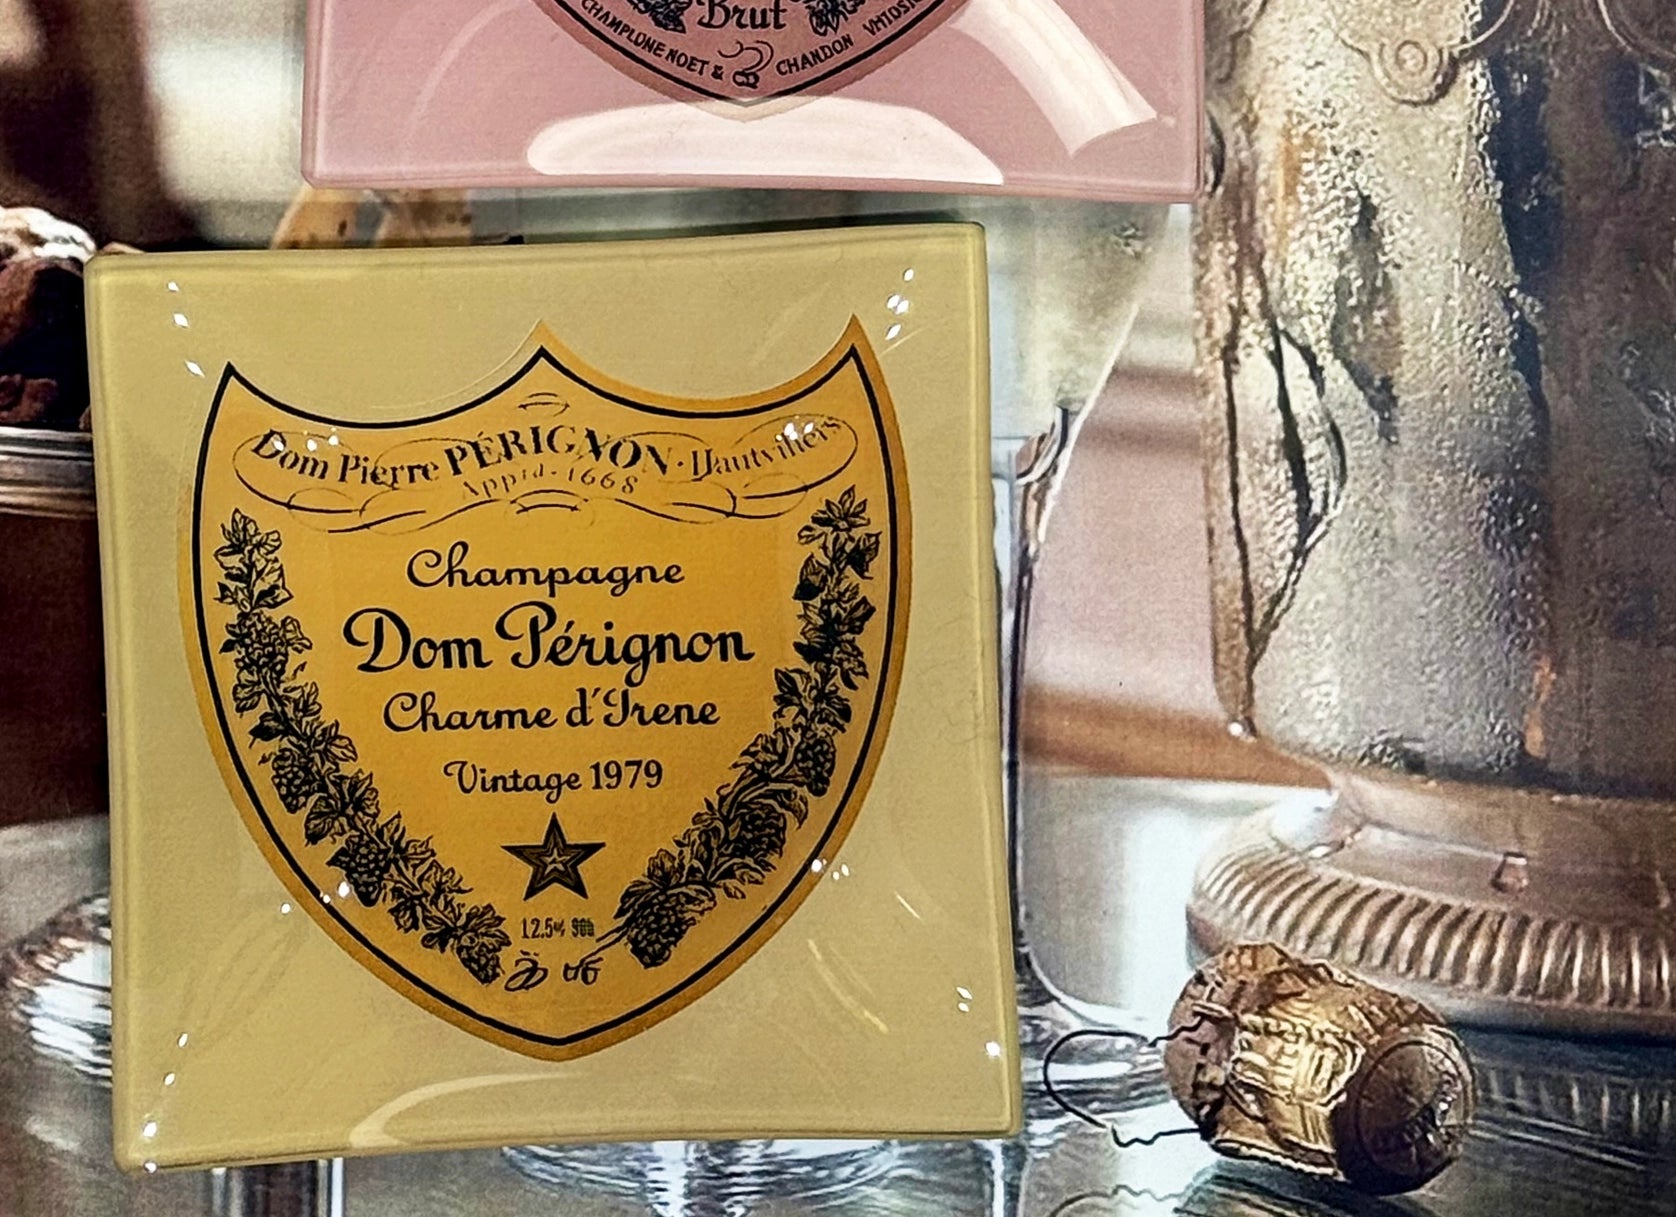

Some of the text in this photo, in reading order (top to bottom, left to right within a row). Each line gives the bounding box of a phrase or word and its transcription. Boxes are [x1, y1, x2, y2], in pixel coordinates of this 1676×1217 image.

[776, 34, 854, 76] CHANDON
[251, 429, 329, 480] Dom
[338, 453, 440, 487] Pierre
[568, 467, 639, 495] 1668
[406, 540, 685, 598] Champagne
[342, 600, 755, 687] Dom Pérignon
[383, 691, 558, 733] Charme
[443, 759, 664, 804] Vintage 1979
